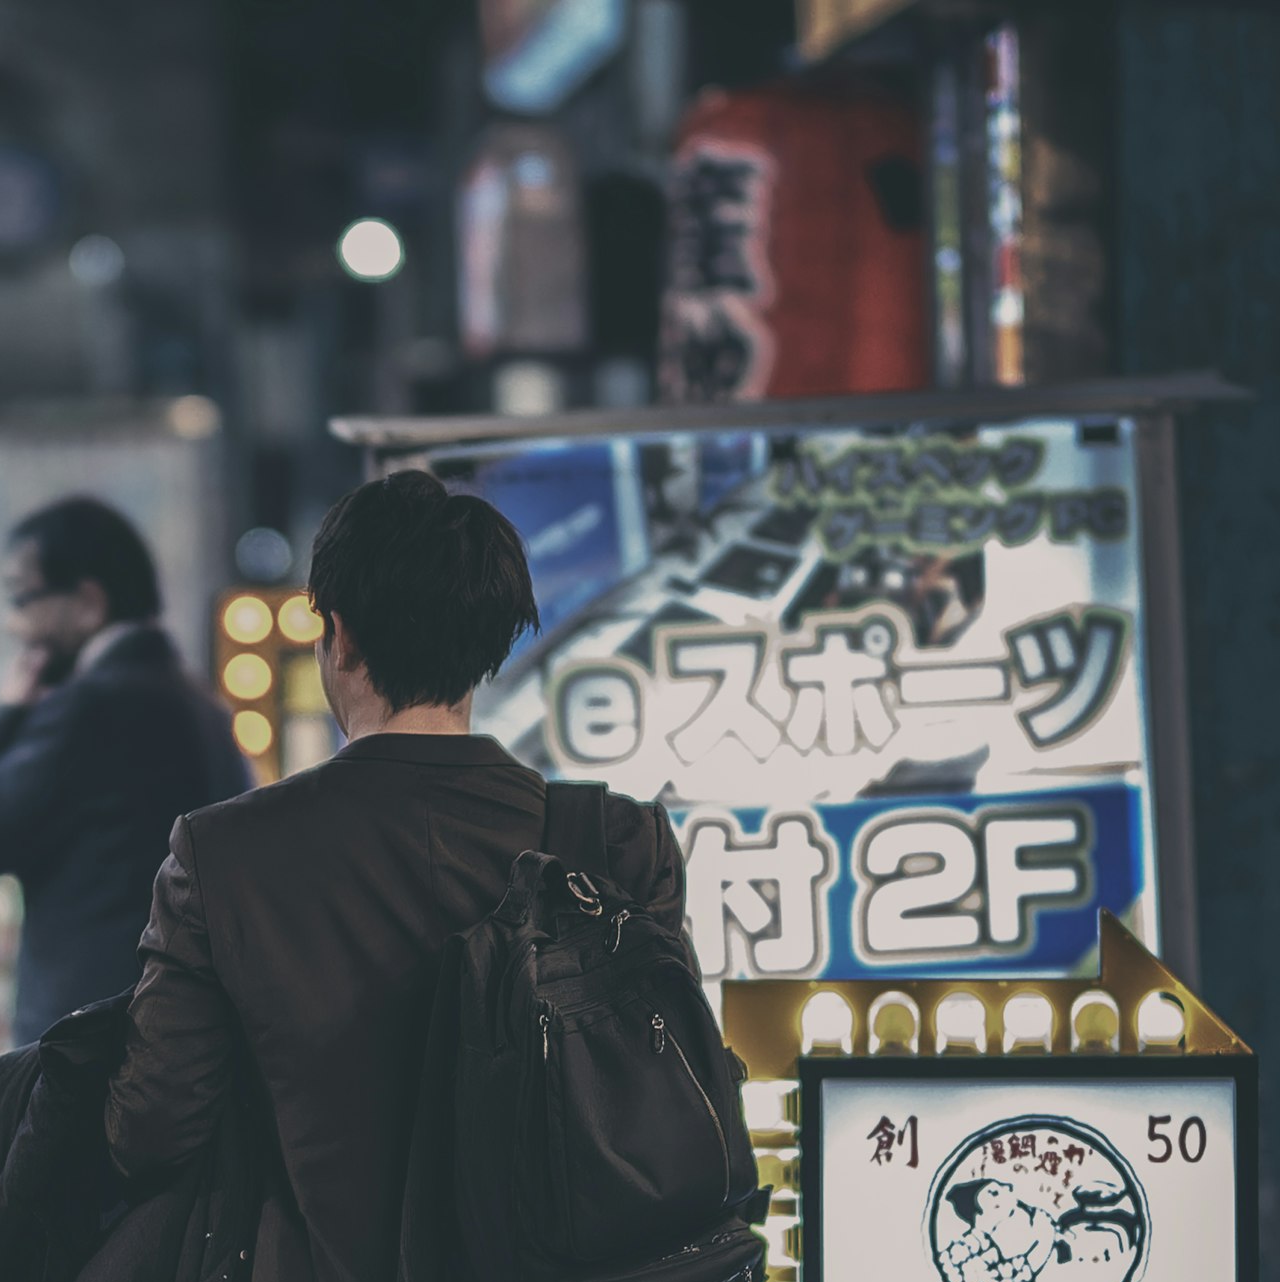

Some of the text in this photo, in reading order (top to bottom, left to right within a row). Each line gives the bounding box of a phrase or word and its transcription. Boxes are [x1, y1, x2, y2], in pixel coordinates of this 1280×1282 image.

[560, 610, 1122, 764] eスポーツ
[866, 817, 1078, 952] 2F
[1147, 1114, 1208, 1164] 50
